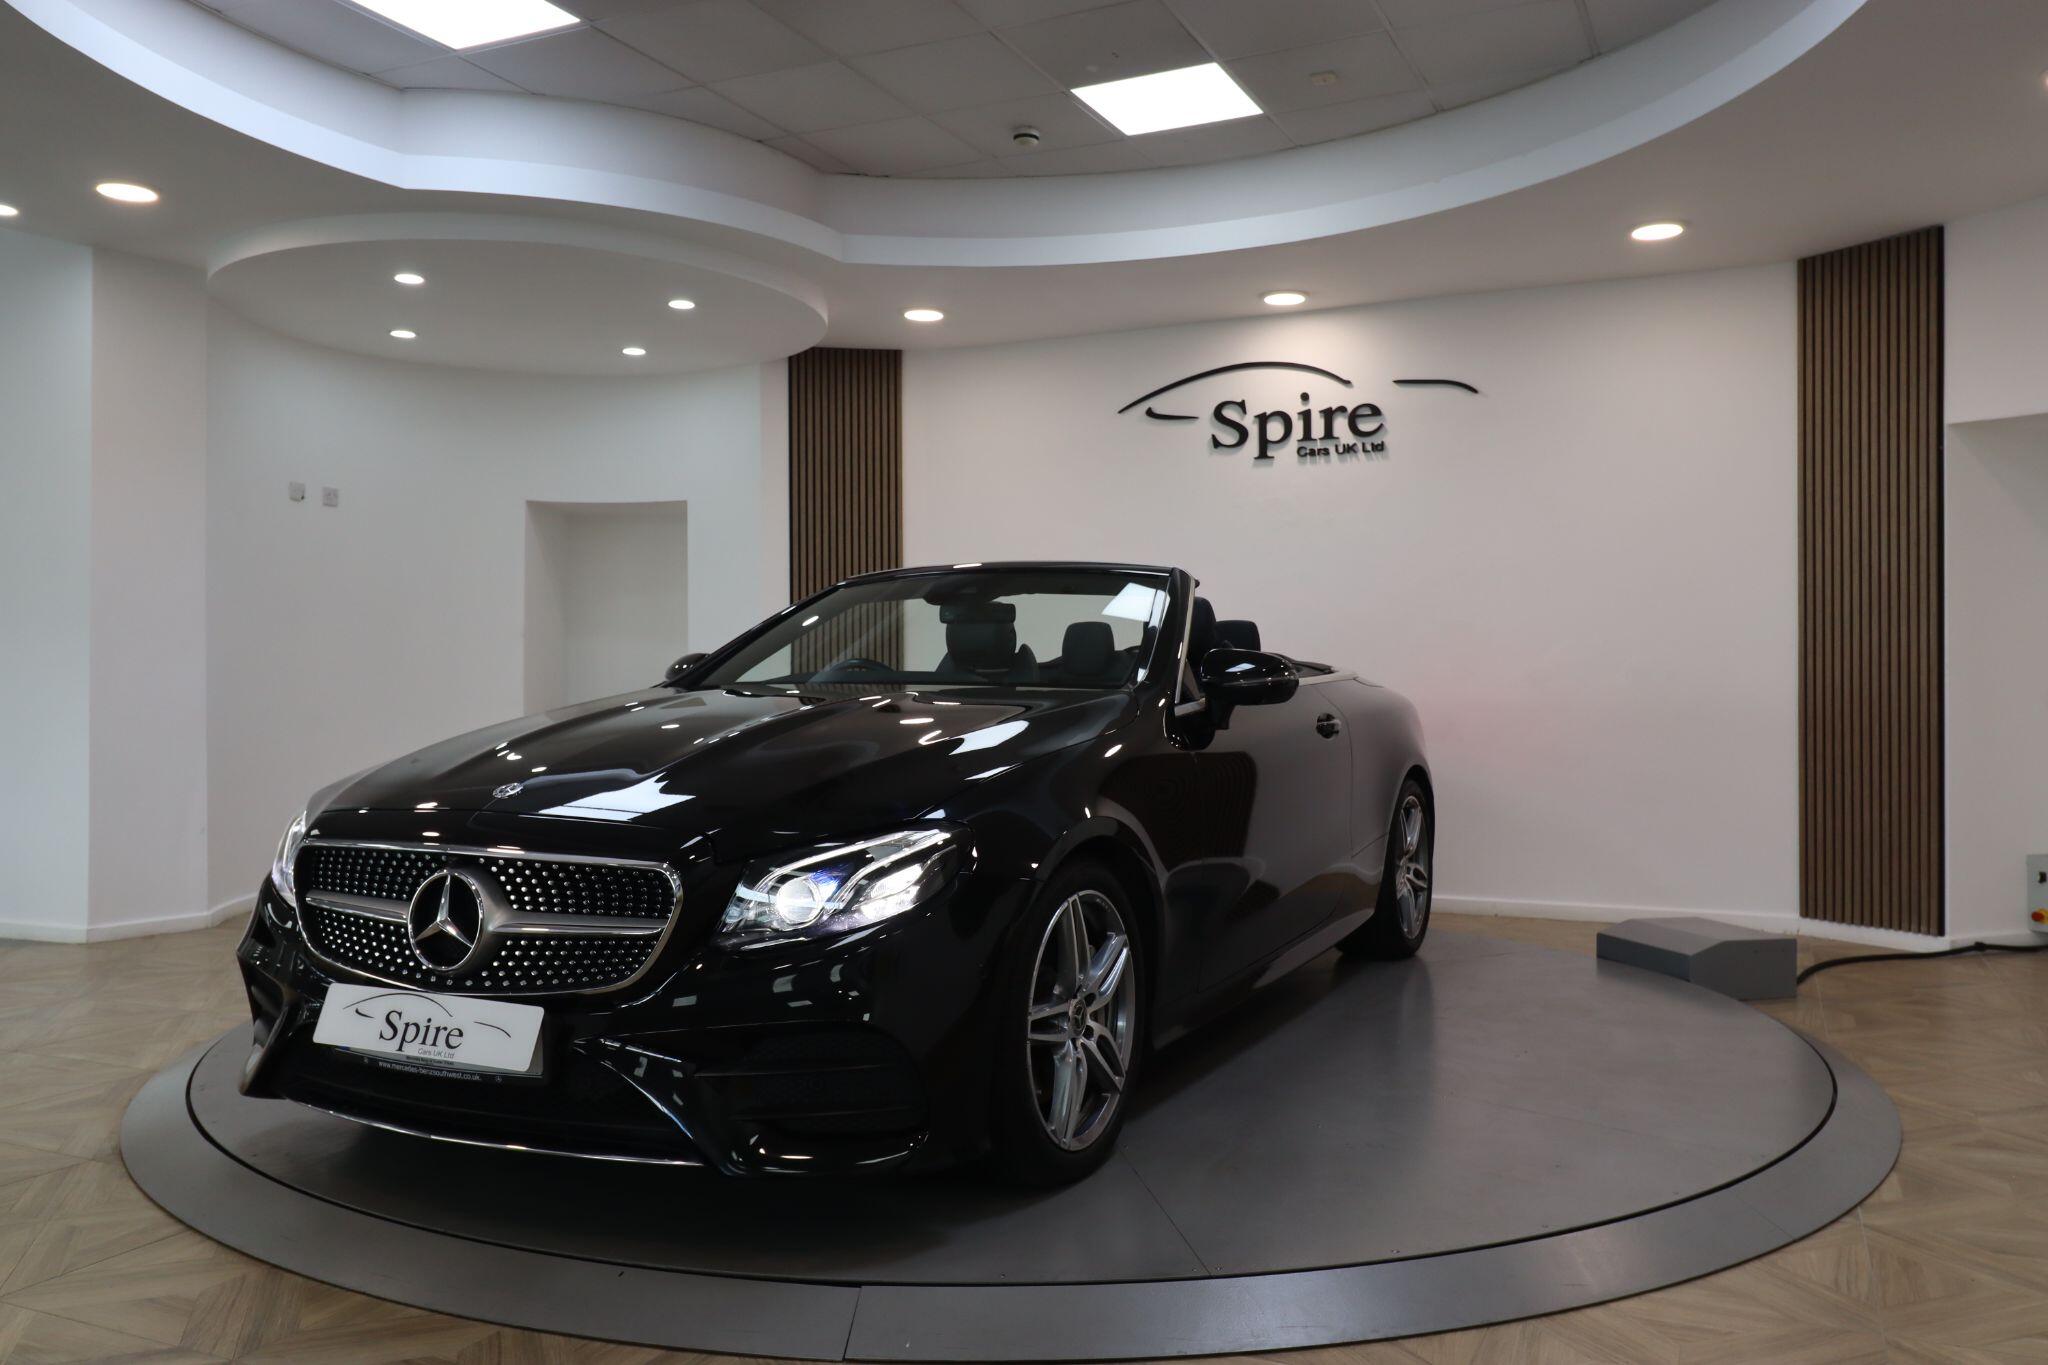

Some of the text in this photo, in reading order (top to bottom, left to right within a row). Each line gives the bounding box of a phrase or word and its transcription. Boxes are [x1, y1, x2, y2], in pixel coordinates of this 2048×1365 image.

[1211, 392, 1384, 460] Spire
[1297, 440, 1384, 457] Cars UK Ltd
[379, 1010, 464, 1052] Spire
[417, 1048, 455, 1059] Cars UK Ltd
